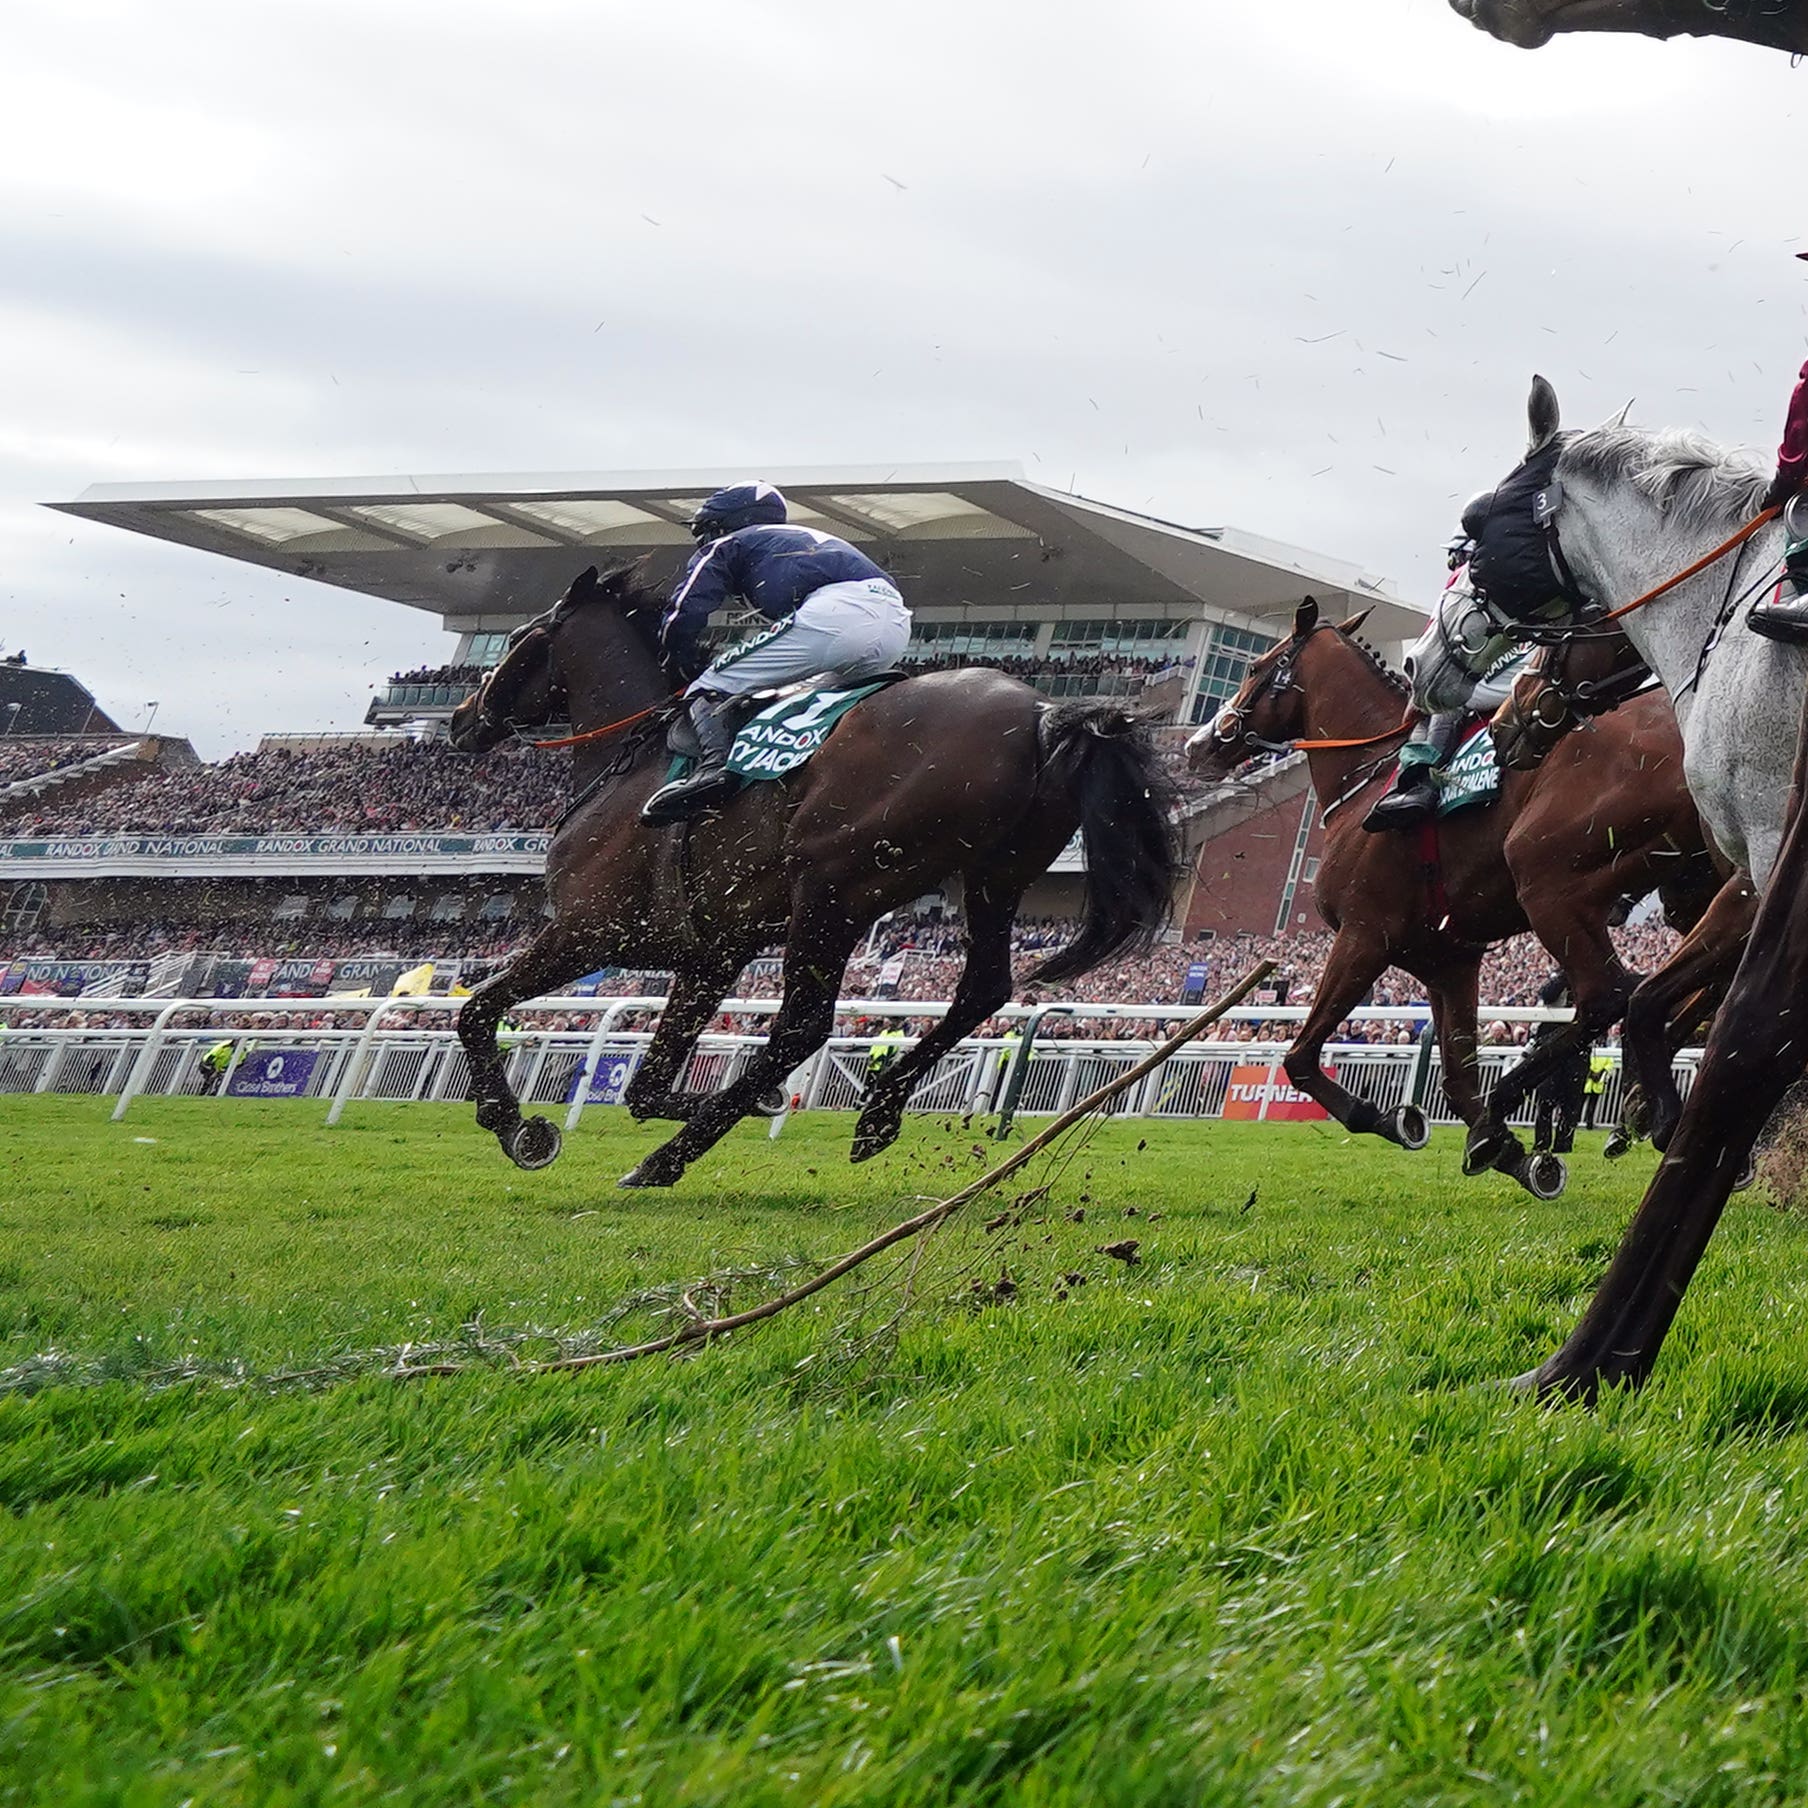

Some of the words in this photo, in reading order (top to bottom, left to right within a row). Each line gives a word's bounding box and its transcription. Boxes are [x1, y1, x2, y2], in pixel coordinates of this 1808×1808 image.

[1537, 493, 1547, 510] 3
[1275, 670, 1291, 684] 14
[737, 725, 828, 750] ANDOX
[45, 843, 101, 857] RANDOX
[144, 840, 224, 855] NATIONAL
[256, 839, 314, 853] RANDOX
[318, 839, 367, 853] GRAND
[372, 838, 442, 853] NATIONAL
